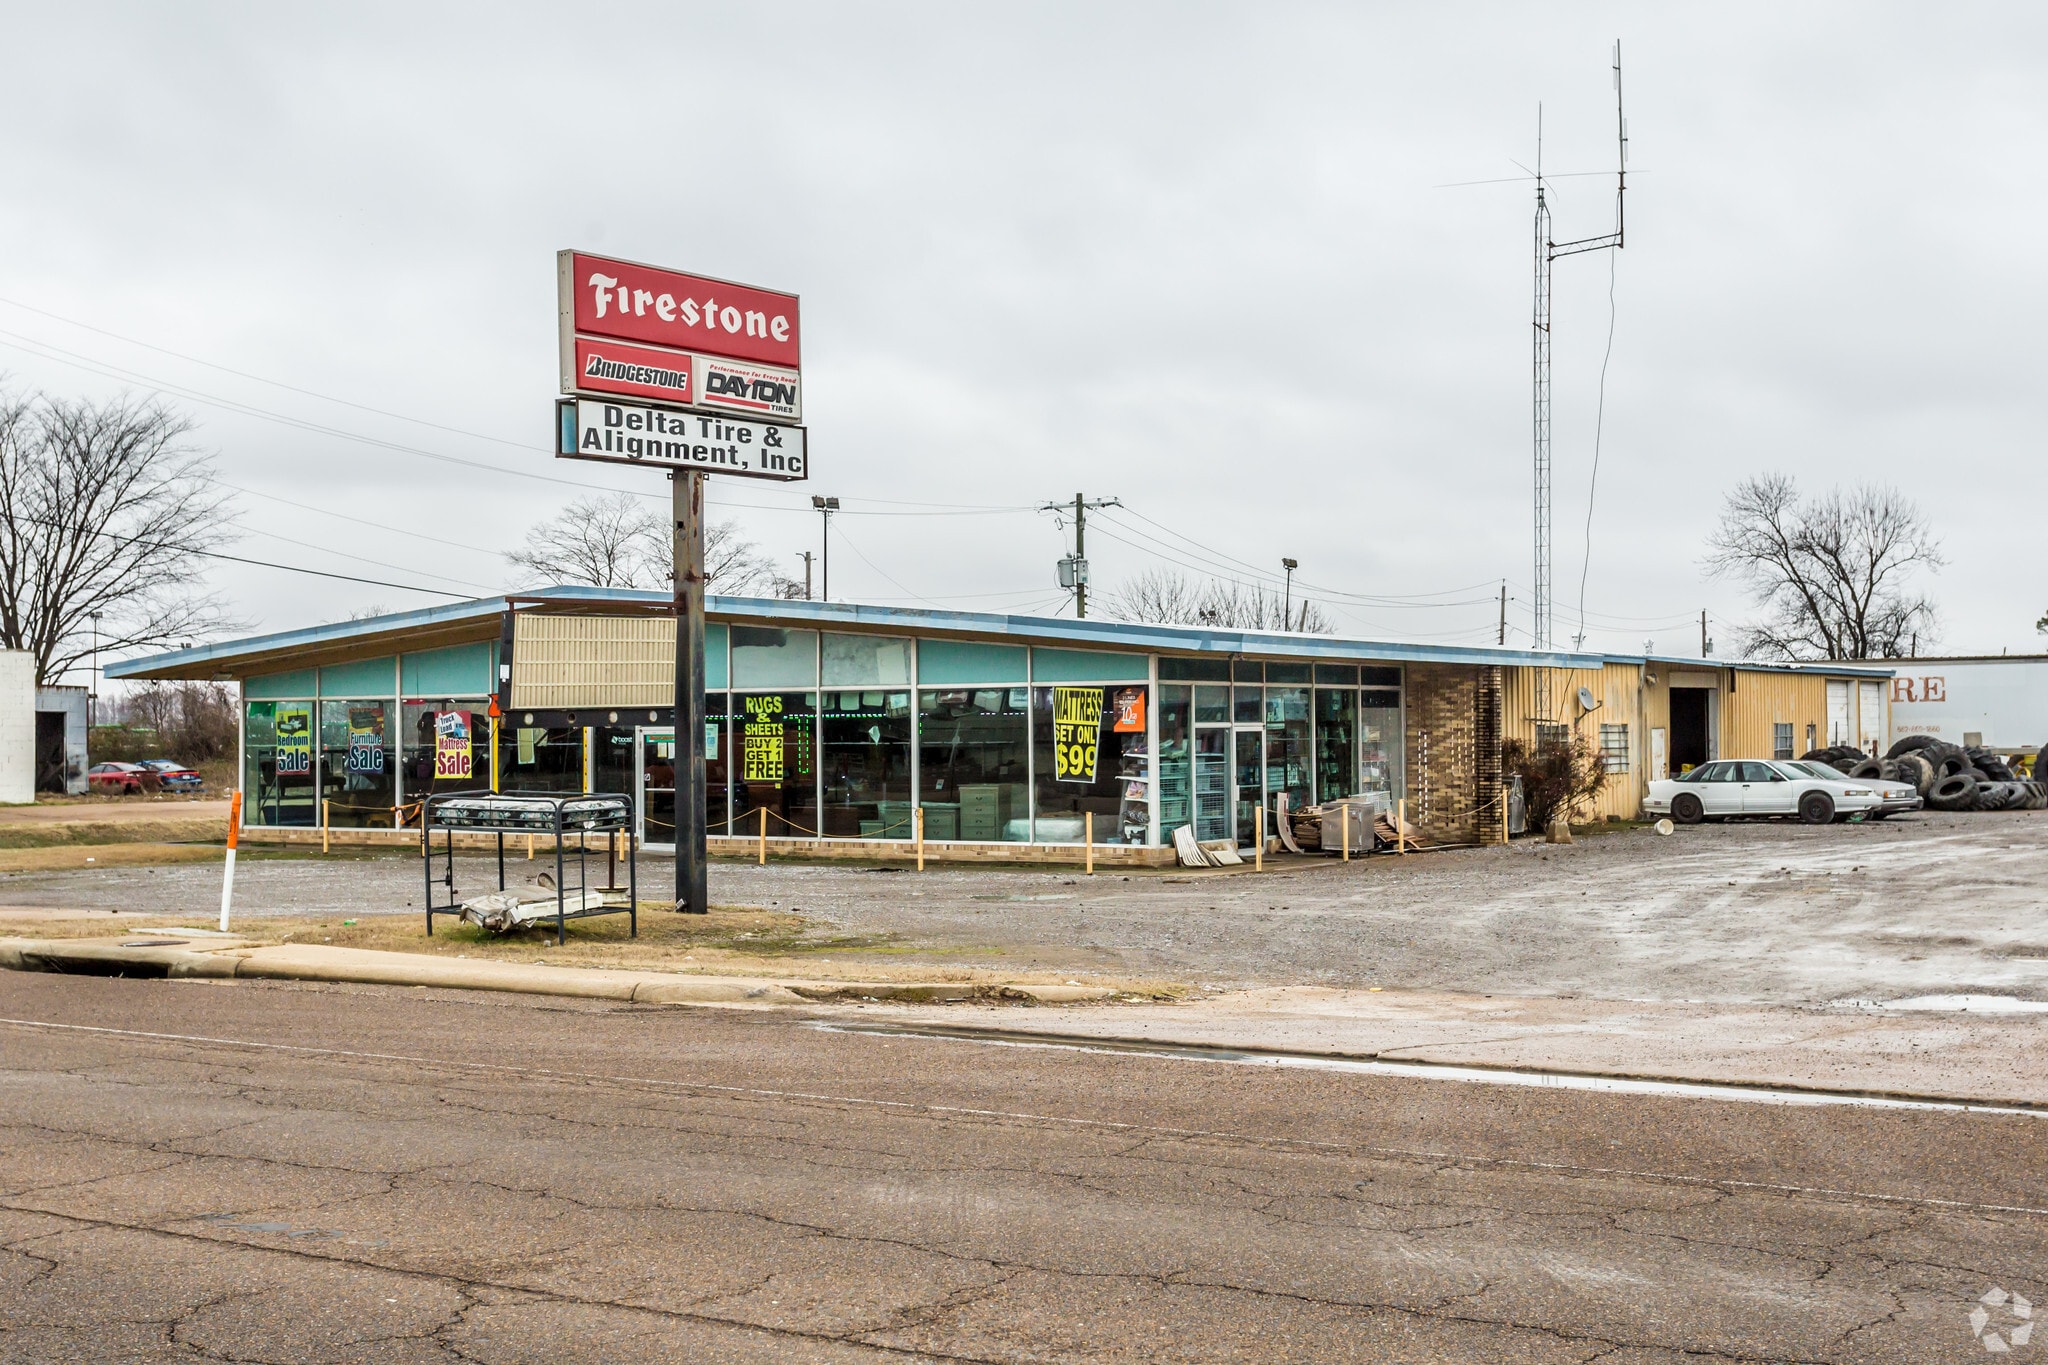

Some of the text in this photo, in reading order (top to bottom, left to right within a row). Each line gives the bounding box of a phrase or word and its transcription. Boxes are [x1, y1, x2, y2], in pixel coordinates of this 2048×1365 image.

[588, 273, 790, 342] Firestone
[586, 355, 687, 390] BRIDGESTONE
[710, 364, 750, 376] Performance
[763, 374, 779, 382] Every
[706, 371, 796, 405] DAYTON
[771, 404, 793, 413] TIRES
[604, 405, 783, 448] Delta Tire &
[582, 427, 802, 473] Alignment, Inc
[745, 696, 783, 713] RUGS
[1055, 689, 1102, 722] MATTRESS
[440, 714, 455, 725] Truck
[756, 713, 771, 722] &
[440, 723, 453, 733] Load
[745, 723, 783, 736] SHEETS
[1056, 725, 1074, 742] SET
[277, 734, 308, 746] Bedroom
[350, 731, 382, 746] Furniture
[438, 737, 467, 750] Mattress
[746, 738, 782, 748] BUY 2
[278, 748, 309, 771] Sale
[350, 745, 383, 770] Sale
[437, 751, 470, 775] Sale
[746, 750, 781, 760] GET 1
[1057, 742, 1097, 778] $99
[746, 761, 783, 778] FREE
